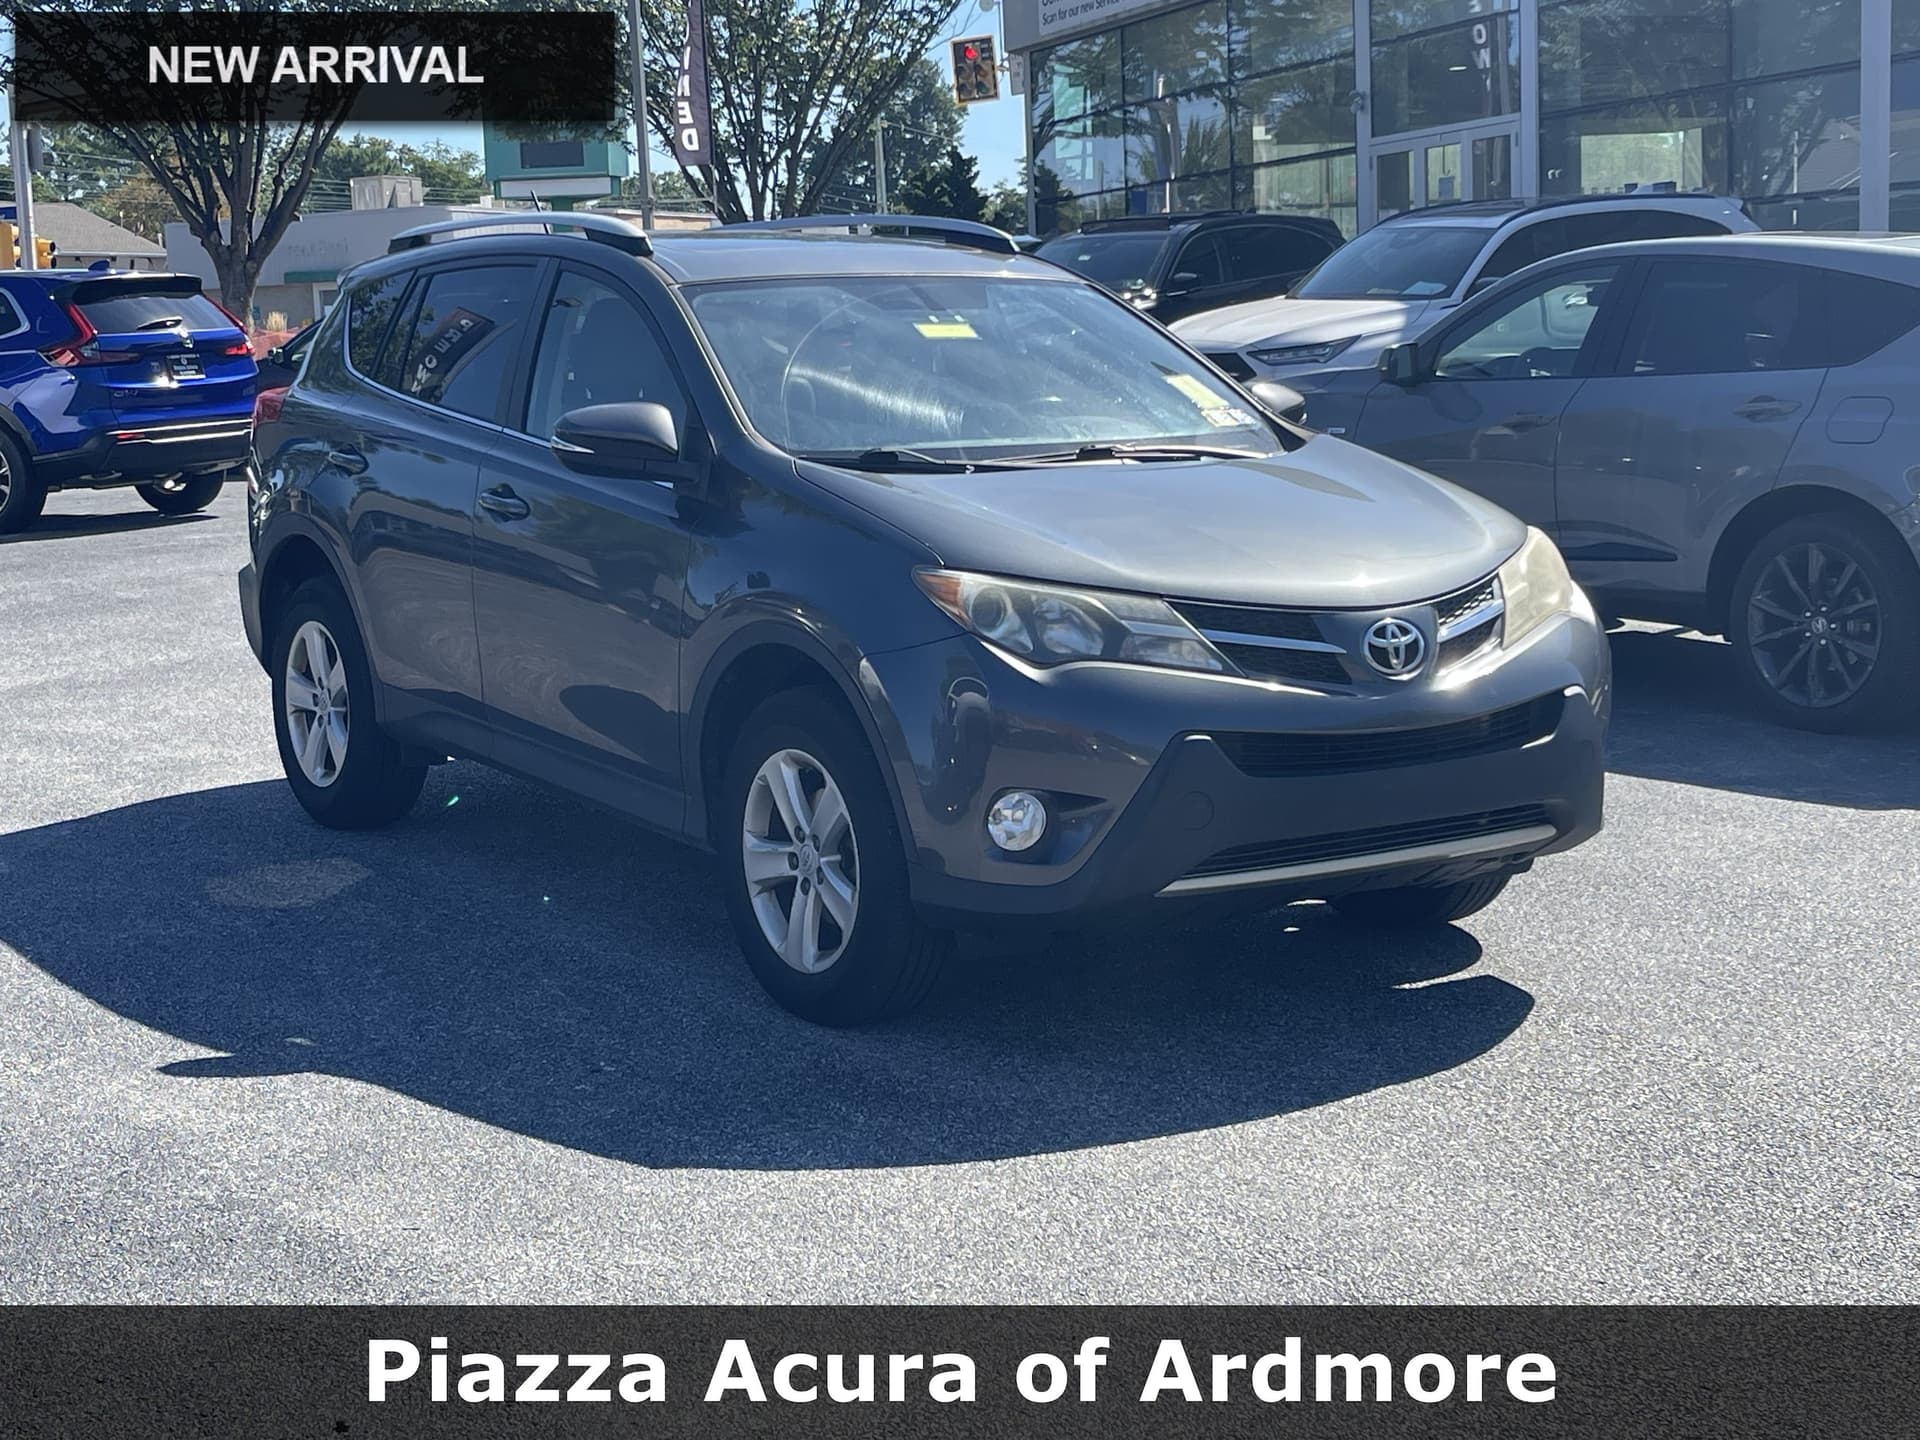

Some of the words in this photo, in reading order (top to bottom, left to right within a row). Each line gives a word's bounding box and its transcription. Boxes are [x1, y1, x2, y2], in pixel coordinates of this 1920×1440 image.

[1042, 12, 1057, 26] Scan
[1058, 8, 1067, 20] for
[1068, 6, 1079, 18] our
[1080, 2, 1095, 14] new
